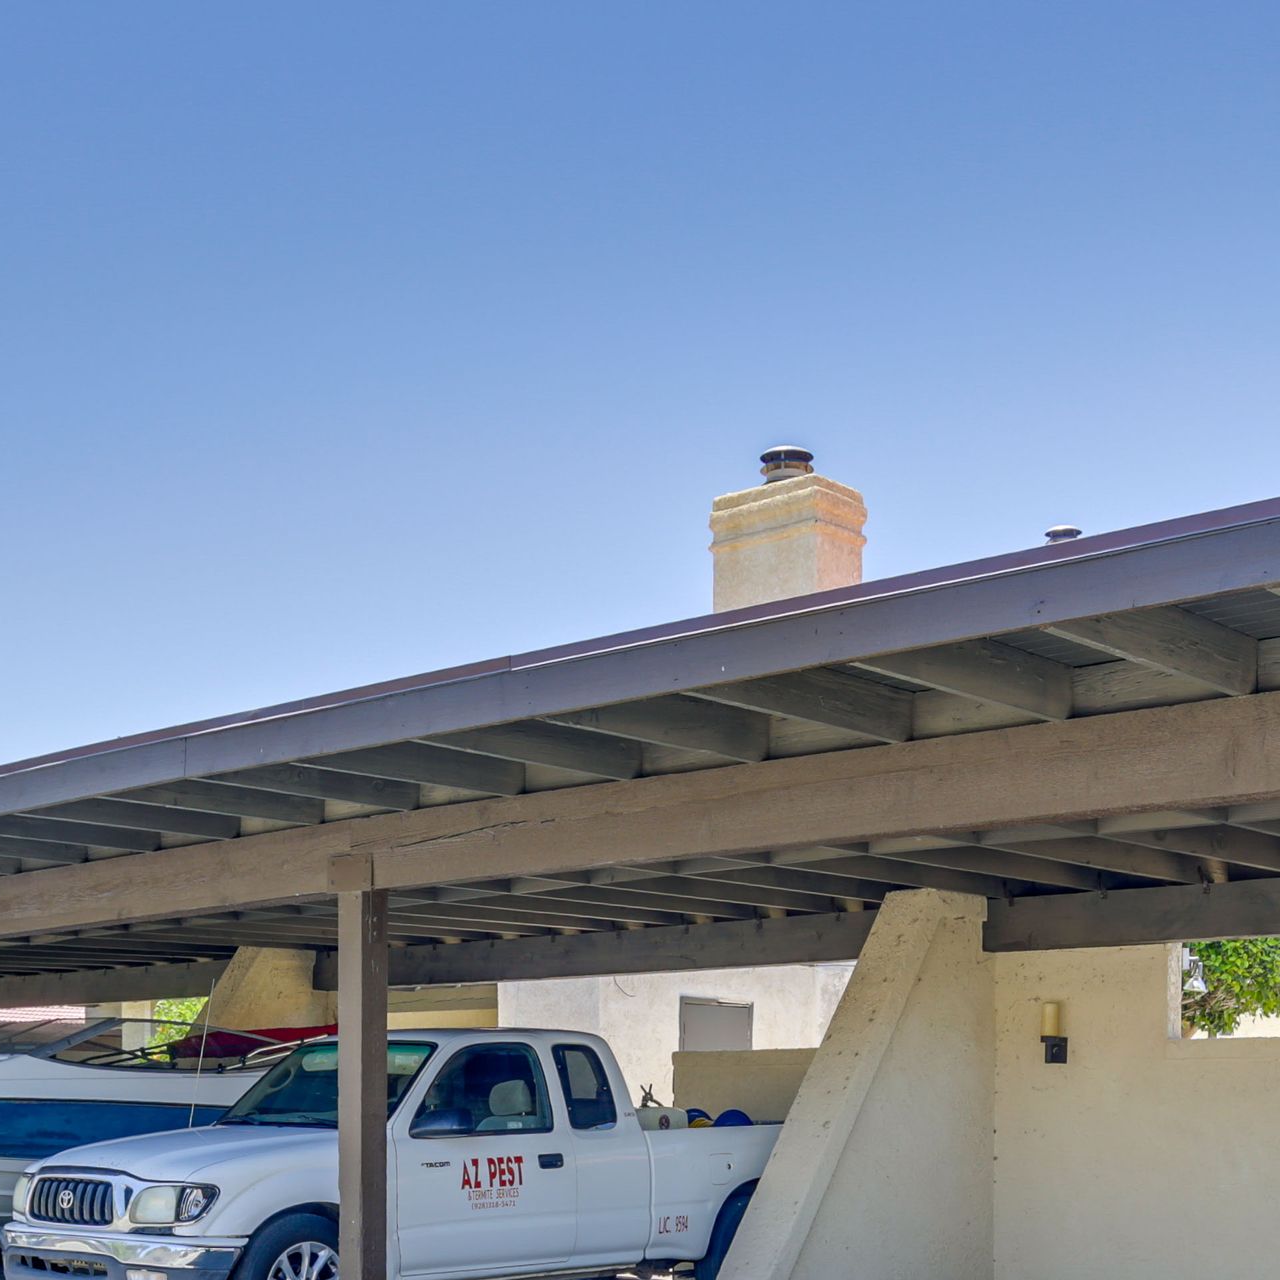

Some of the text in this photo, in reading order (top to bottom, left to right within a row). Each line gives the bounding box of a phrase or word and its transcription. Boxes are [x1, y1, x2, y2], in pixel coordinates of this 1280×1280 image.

[461, 1155, 523, 1189] AZ PEST
[496, 1187, 520, 1199] SERVICES
